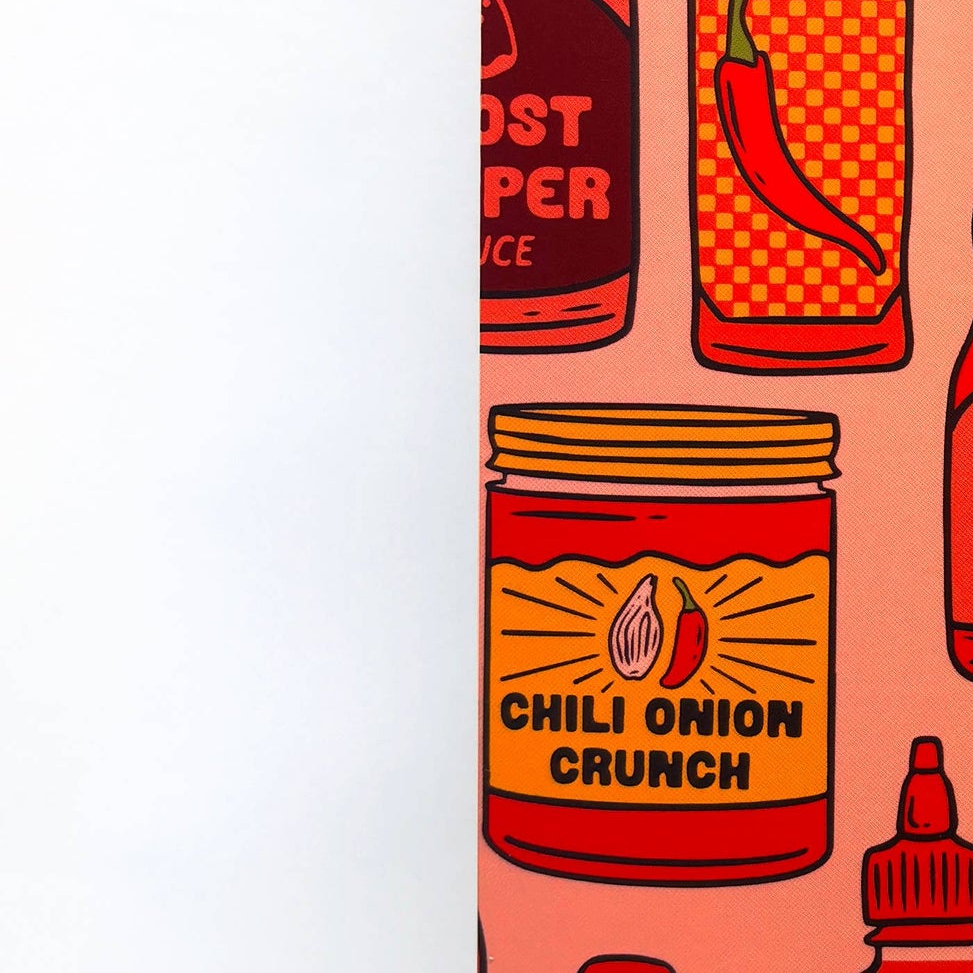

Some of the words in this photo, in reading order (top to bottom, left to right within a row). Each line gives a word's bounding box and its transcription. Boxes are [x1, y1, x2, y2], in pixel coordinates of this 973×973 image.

[480, 235, 536, 267] CE
[500, 692, 625, 734] CHILI
[645, 697, 803, 738] ONION
[550, 746, 751, 790] CRUNCH
